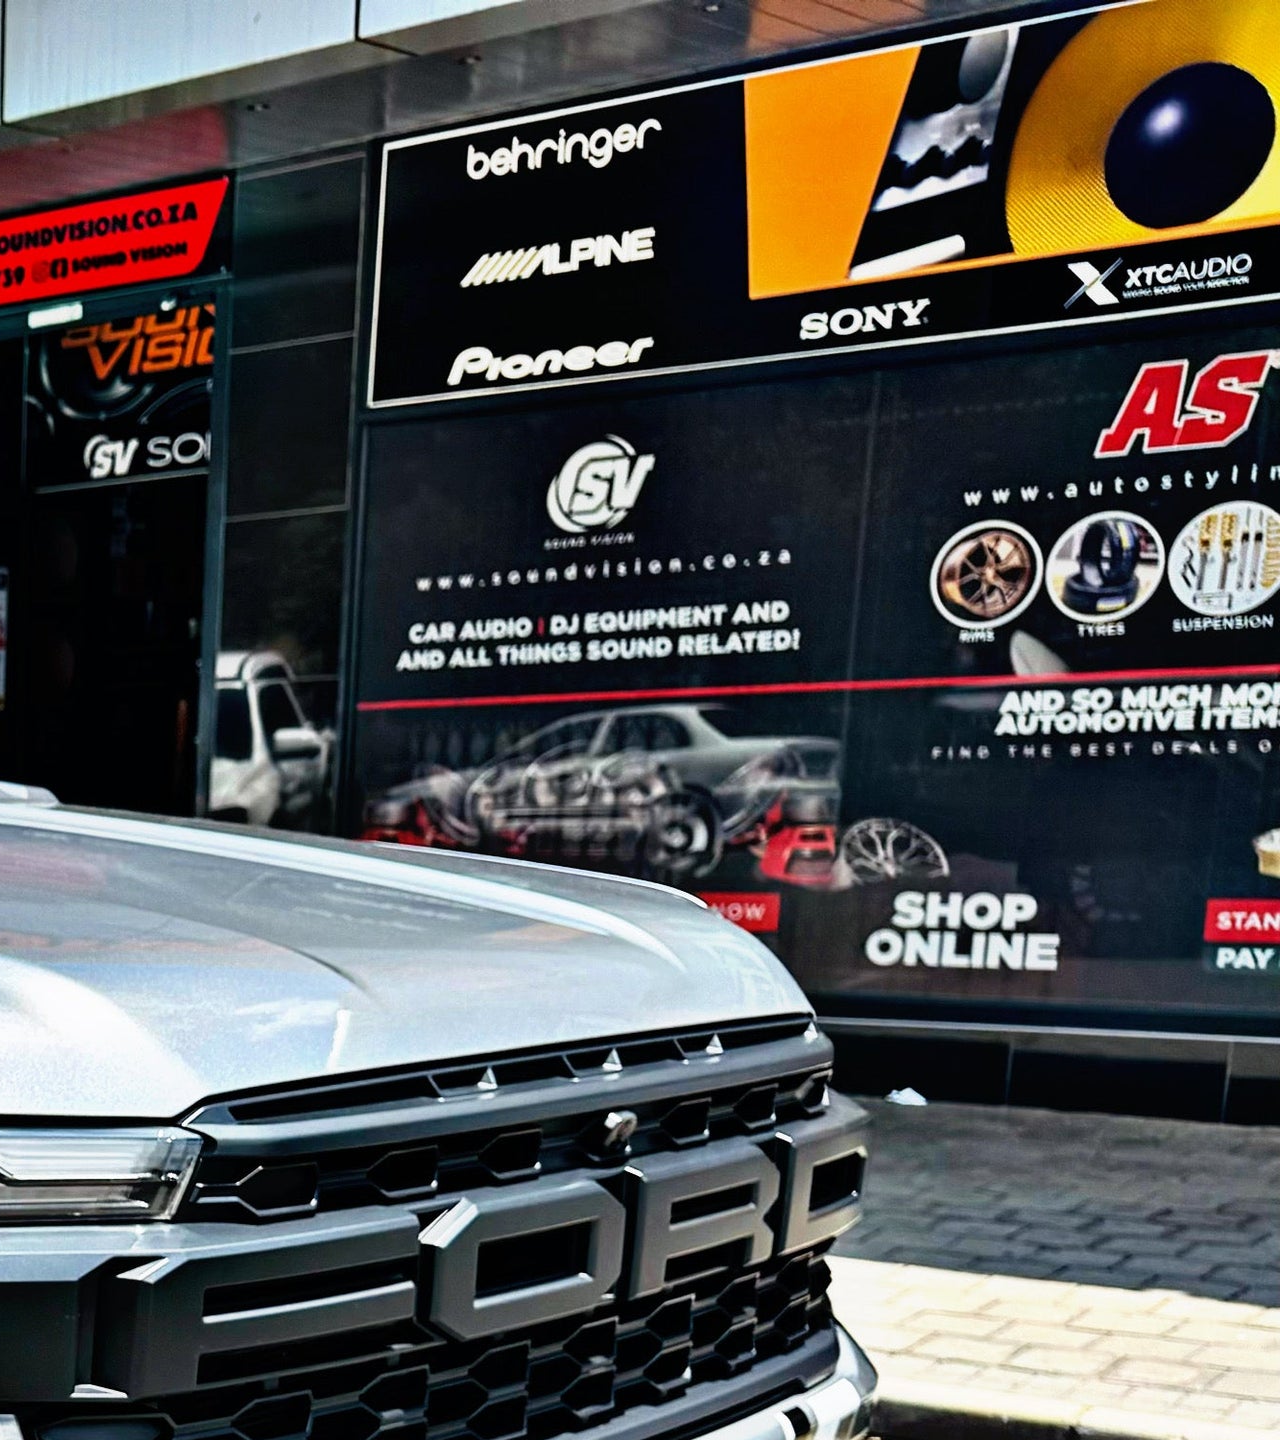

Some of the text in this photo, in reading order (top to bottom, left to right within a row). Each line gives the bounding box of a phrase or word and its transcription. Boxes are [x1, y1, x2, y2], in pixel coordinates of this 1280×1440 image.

[465, 118, 663, 181] behringer
[459, 226, 656, 288] ALPINE
[799, 298, 931, 341] SONY
[446, 336, 654, 386] Pioneer
[1094, 350, 1271, 459] AS
[415, 548, 792, 592] www.soundvision.co.za
[408, 600, 791, 644] CAR AUDIO DJ EQUIPMENT AND
[958, 629, 996, 644] RIMS
[1076, 623, 1126, 638] TYRES
[1171, 614, 1275, 633] SUSPENSION
[396, 627, 801, 672] AND ALL THINGS SOUND RELATED!
[999, 689, 1066, 713] AND
[1071, 687, 1114, 713] SO
[1121, 684, 1213, 712] MUCH
[993, 705, 1280, 736] AUTOMOTIVE ITEM
[931, 745, 991, 761] FIND
[1007, 743, 1053, 759] THE
[1070, 741, 1134, 757] BEST
[1152, 739, 1240, 757] DEALS
[891, 891, 1038, 931] SHOP
[864, 929, 1060, 972] ONLINE
[1215, 946, 1276, 970] PAY
[128, 1124, 870, 1398] FORD
